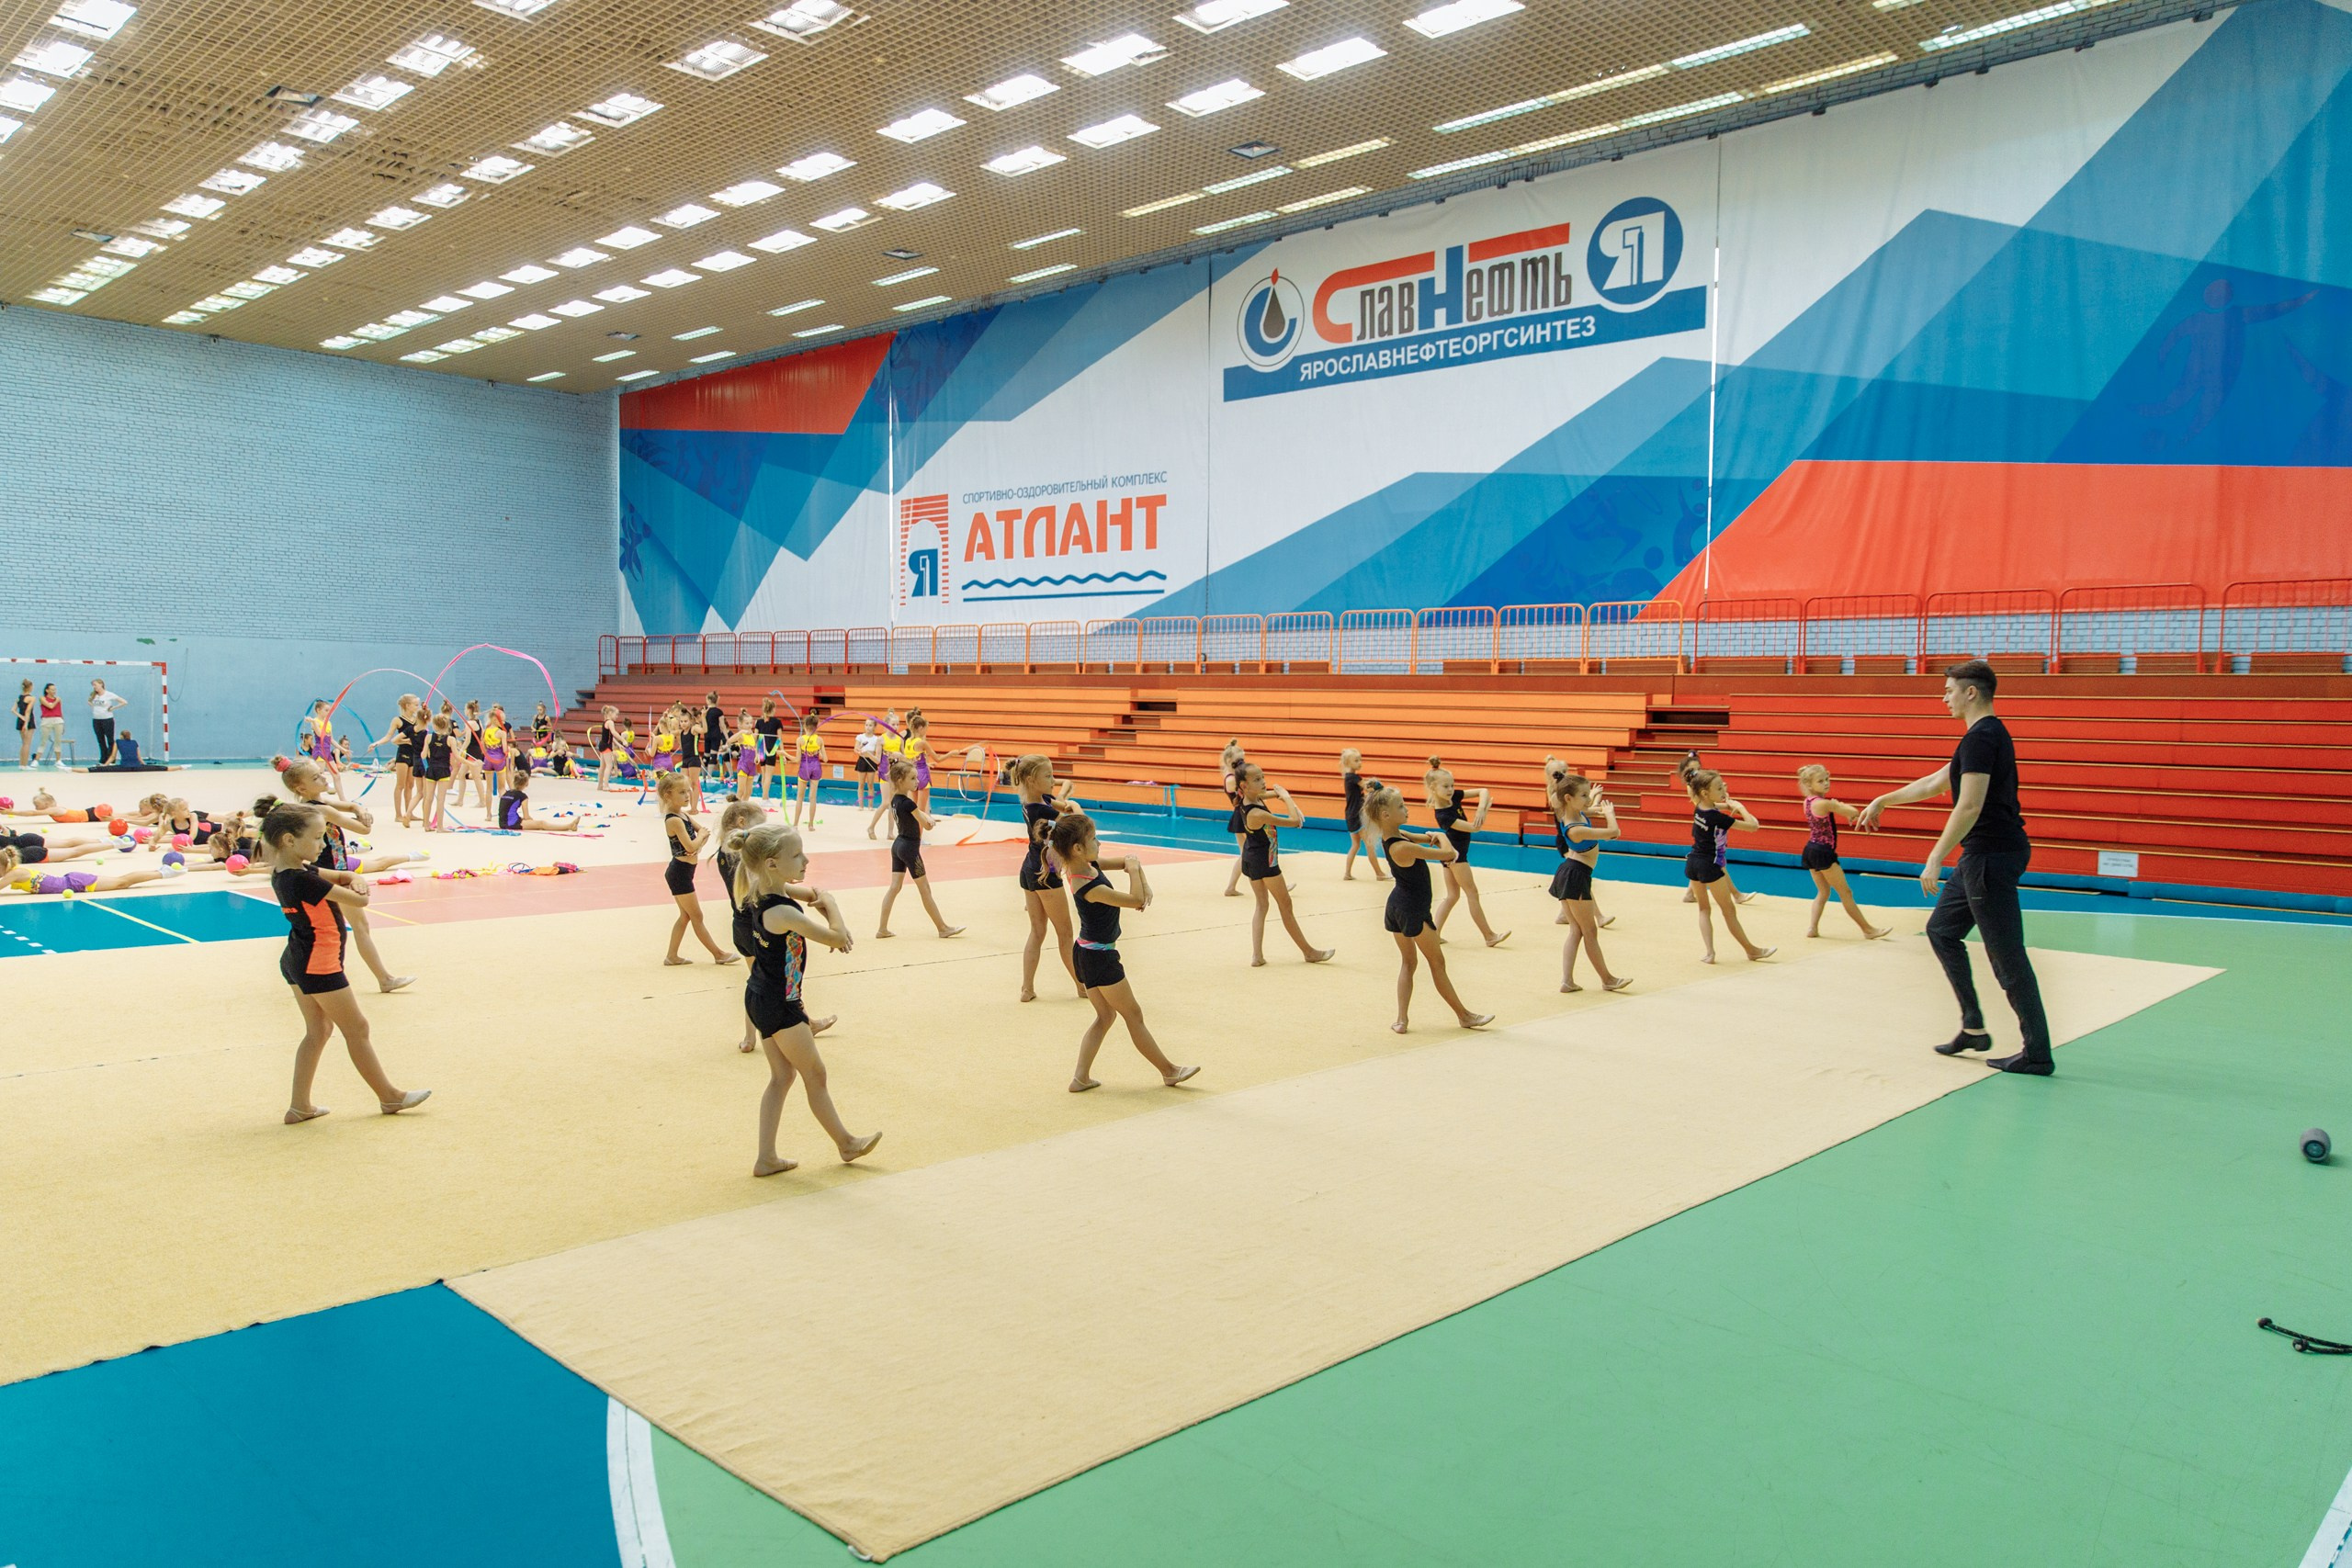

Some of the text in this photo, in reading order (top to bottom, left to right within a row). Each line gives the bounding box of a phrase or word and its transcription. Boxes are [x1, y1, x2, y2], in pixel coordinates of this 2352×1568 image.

[1299, 315, 1597, 381] ЯРОСЛАВНЕФТЕОРГСИНТЕЗ
[963, 471, 1167, 504] СПОРТИВНО-ОЗДОРОВИТЕЛЬНЫЙ КОМПЛЕКС
[964, 494, 1167, 561] АТЛАНТ
